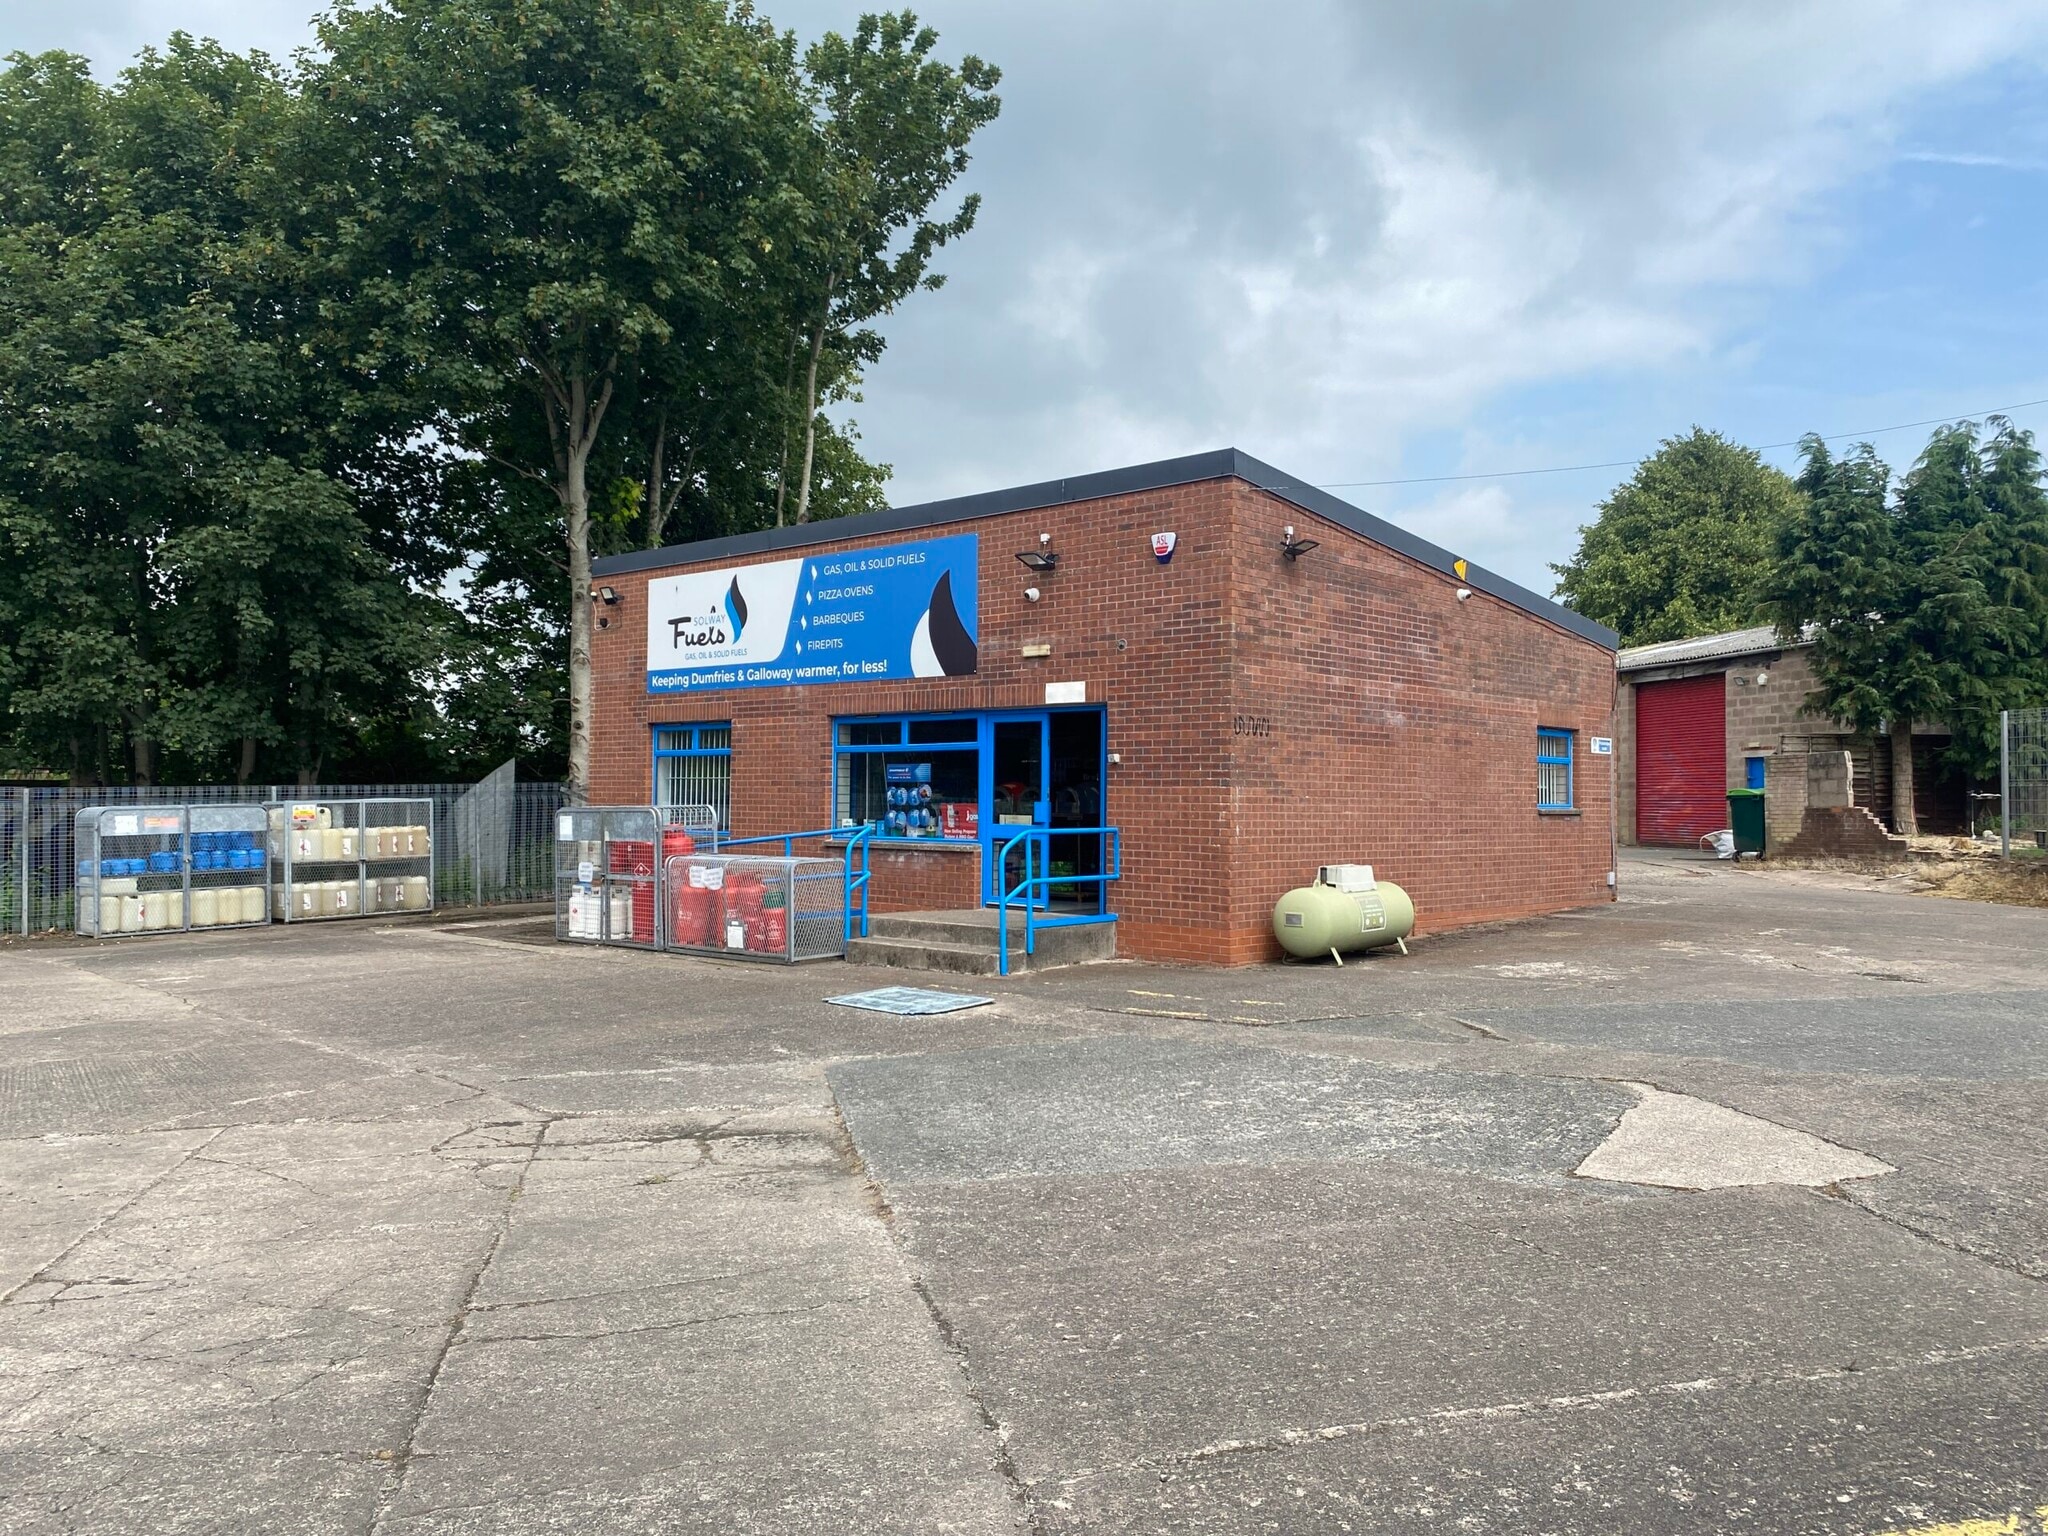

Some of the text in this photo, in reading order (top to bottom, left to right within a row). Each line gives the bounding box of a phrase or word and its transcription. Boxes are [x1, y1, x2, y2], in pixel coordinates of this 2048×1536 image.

[1156, 535, 1168, 545] ASL
[823, 552, 926, 576] GAS, OIL & SOLID FUELS
[818, 585, 874, 601] PIZZA OVENS
[693, 614, 726, 627] SOLWAY
[812, 611, 865, 626] BARBEQUES
[667, 605, 726, 650] Fuels
[807, 638, 843, 651] FIREPITS
[698, 652, 708, 660] OIL
[708, 651, 713, 659] &
[713, 649, 730, 658] SOLID
[730, 648, 748, 657] FUELS
[651, 659, 888, 689] Keeping Dumfries & Galloway warmer, for less!
